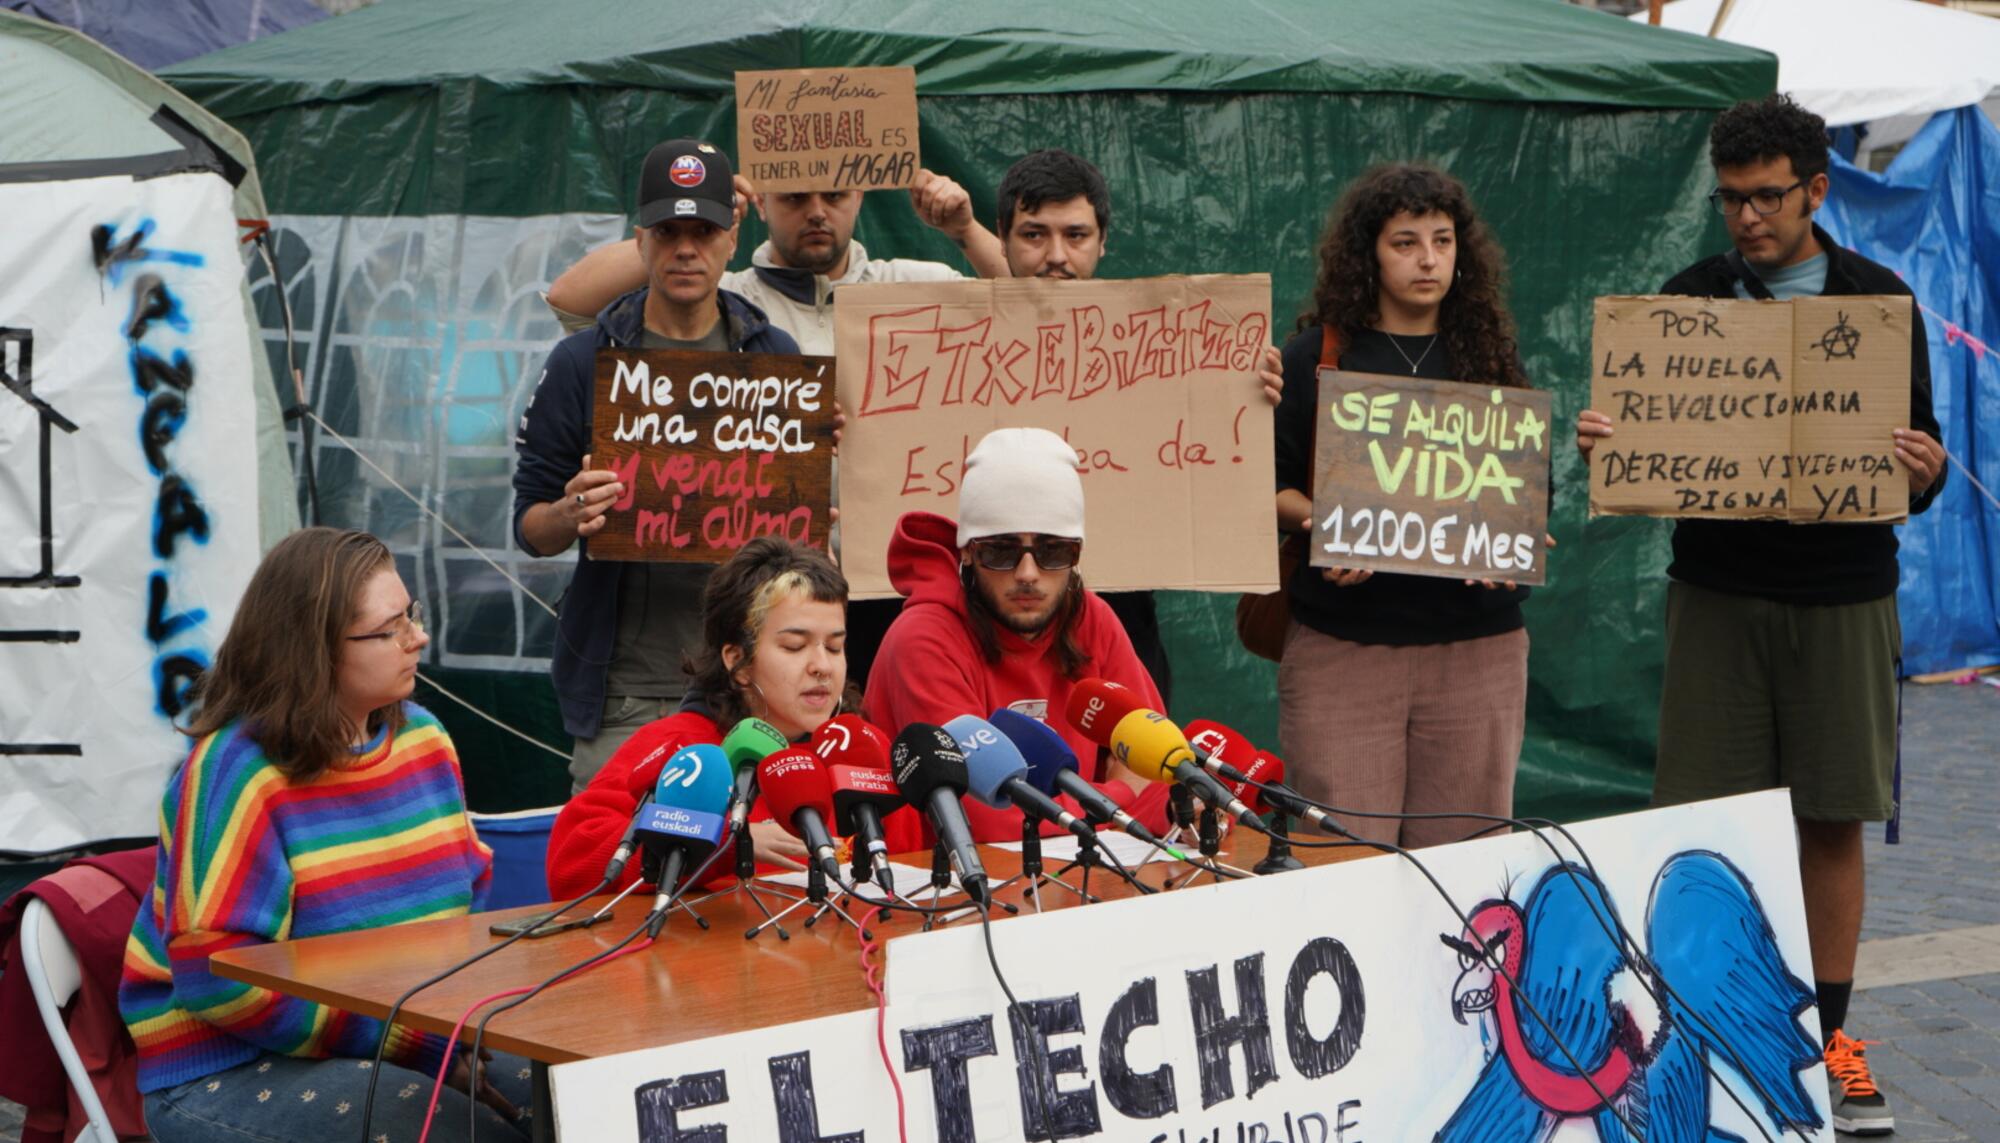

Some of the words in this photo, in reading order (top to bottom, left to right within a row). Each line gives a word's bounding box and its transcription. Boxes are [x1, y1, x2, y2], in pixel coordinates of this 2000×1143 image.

[744, 79, 781, 109] MI
[752, 109, 872, 152] SEXUAL
[881, 128, 907, 147] ES
[750, 160, 800, 180] TENER
[808, 160, 830, 177] UN
[833, 151, 916, 188] HOGAR
[1649, 309, 1725, 338] POR
[1602, 351, 1645, 378] LA
[1665, 354, 1781, 382] HUELGA
[609, 358, 675, 407] Me
[689, 364, 826, 431] compré
[1611, 390, 1861, 423] REVOLUCIONARIA
[1331, 391, 1400, 435] SE
[613, 412, 698, 445] una
[713, 413, 815, 453] casa
[1600, 449, 1740, 488] DERECHO
[1758, 454, 1895, 479] VIVIENDA
[1674, 487, 1788, 511] DIGNA
[1812, 484, 1879, 519] YA!
[634, 495, 691, 548] mi
[1080, 696, 1105, 729] rne
[765, 755, 812, 773] europa
[776, 763, 816, 777] press
[849, 770, 894, 783] euskadi
[851, 778, 888, 791] irratia
[652, 819, 702, 835] euskadi
[655, 809, 690, 823] radio
[899, 936, 1366, 1143] TECHO
